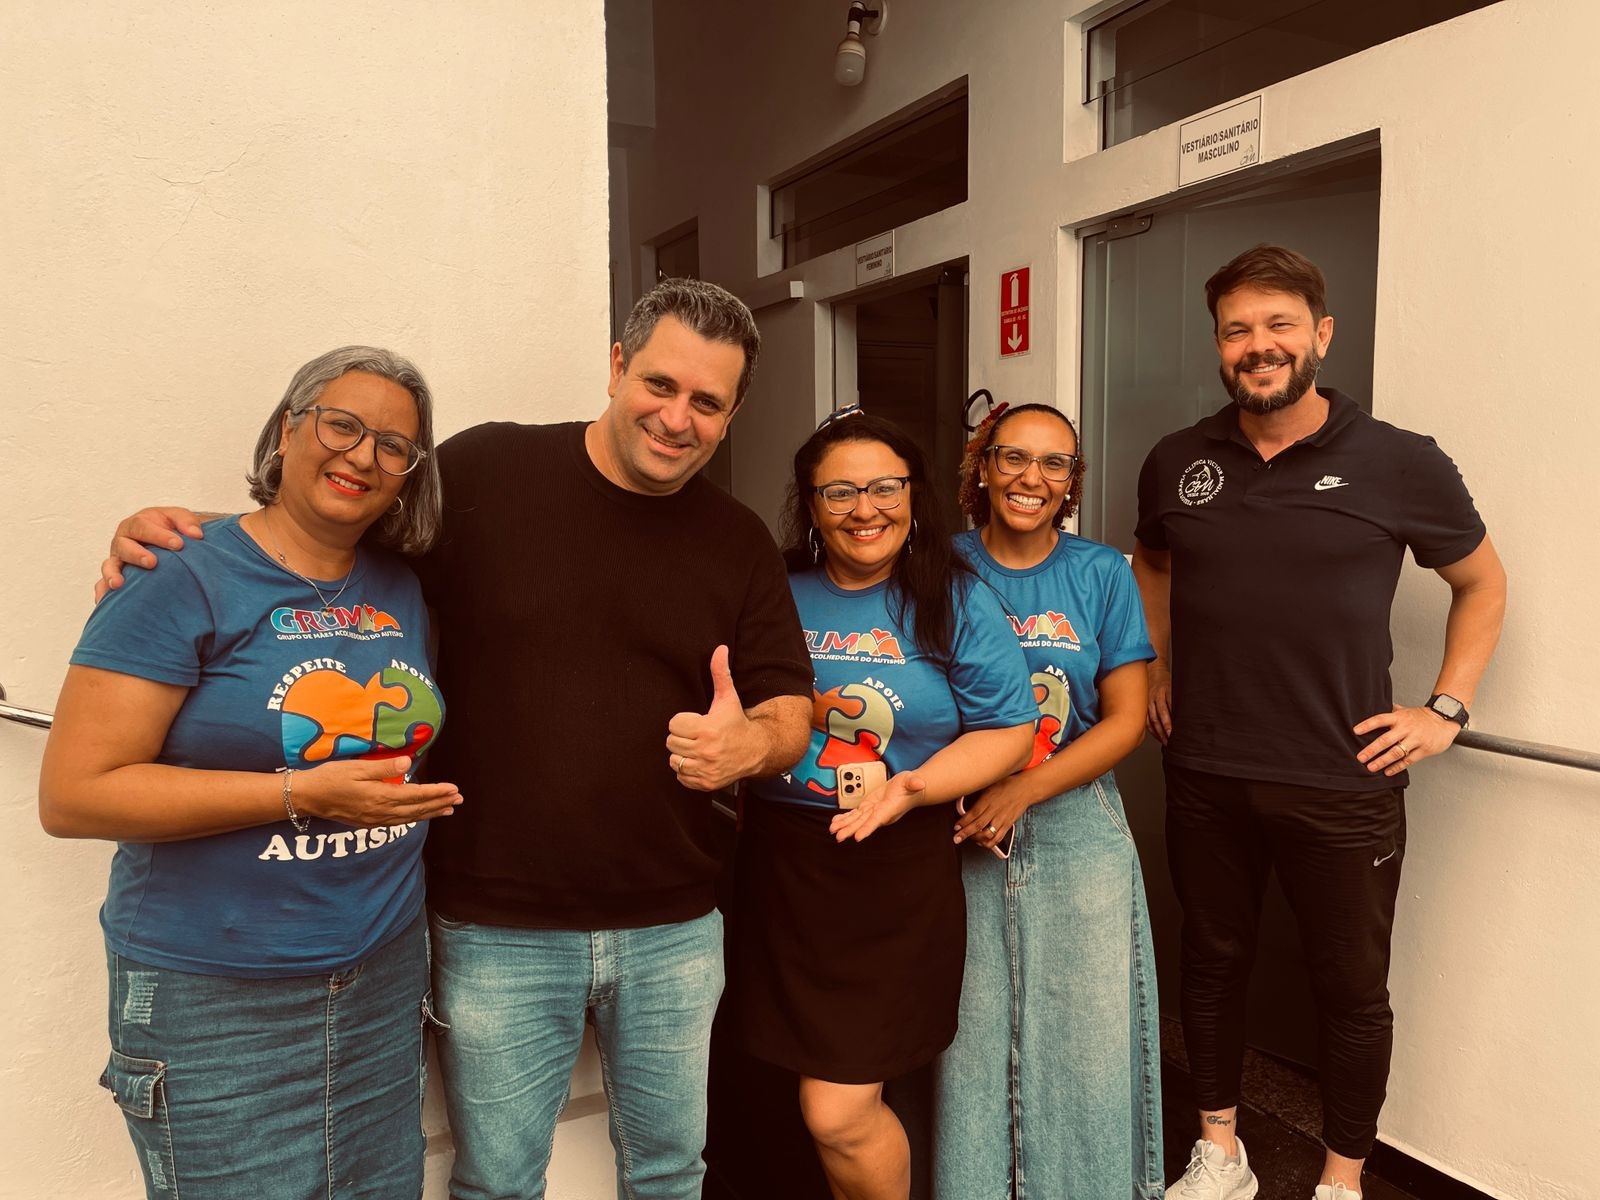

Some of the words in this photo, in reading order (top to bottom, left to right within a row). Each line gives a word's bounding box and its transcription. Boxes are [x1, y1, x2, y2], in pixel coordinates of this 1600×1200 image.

[1198, 140, 1240, 164] MASCULINO
[1320, 475, 1342, 485] NIKE
[1053, 641, 1081, 652] AUTISMO
[873, 657, 906, 665] AUTISMO
[267, 657, 347, 711] RESPEITE
[390, 658, 434, 690] APOIE
[862, 676, 905, 712] APOIE
